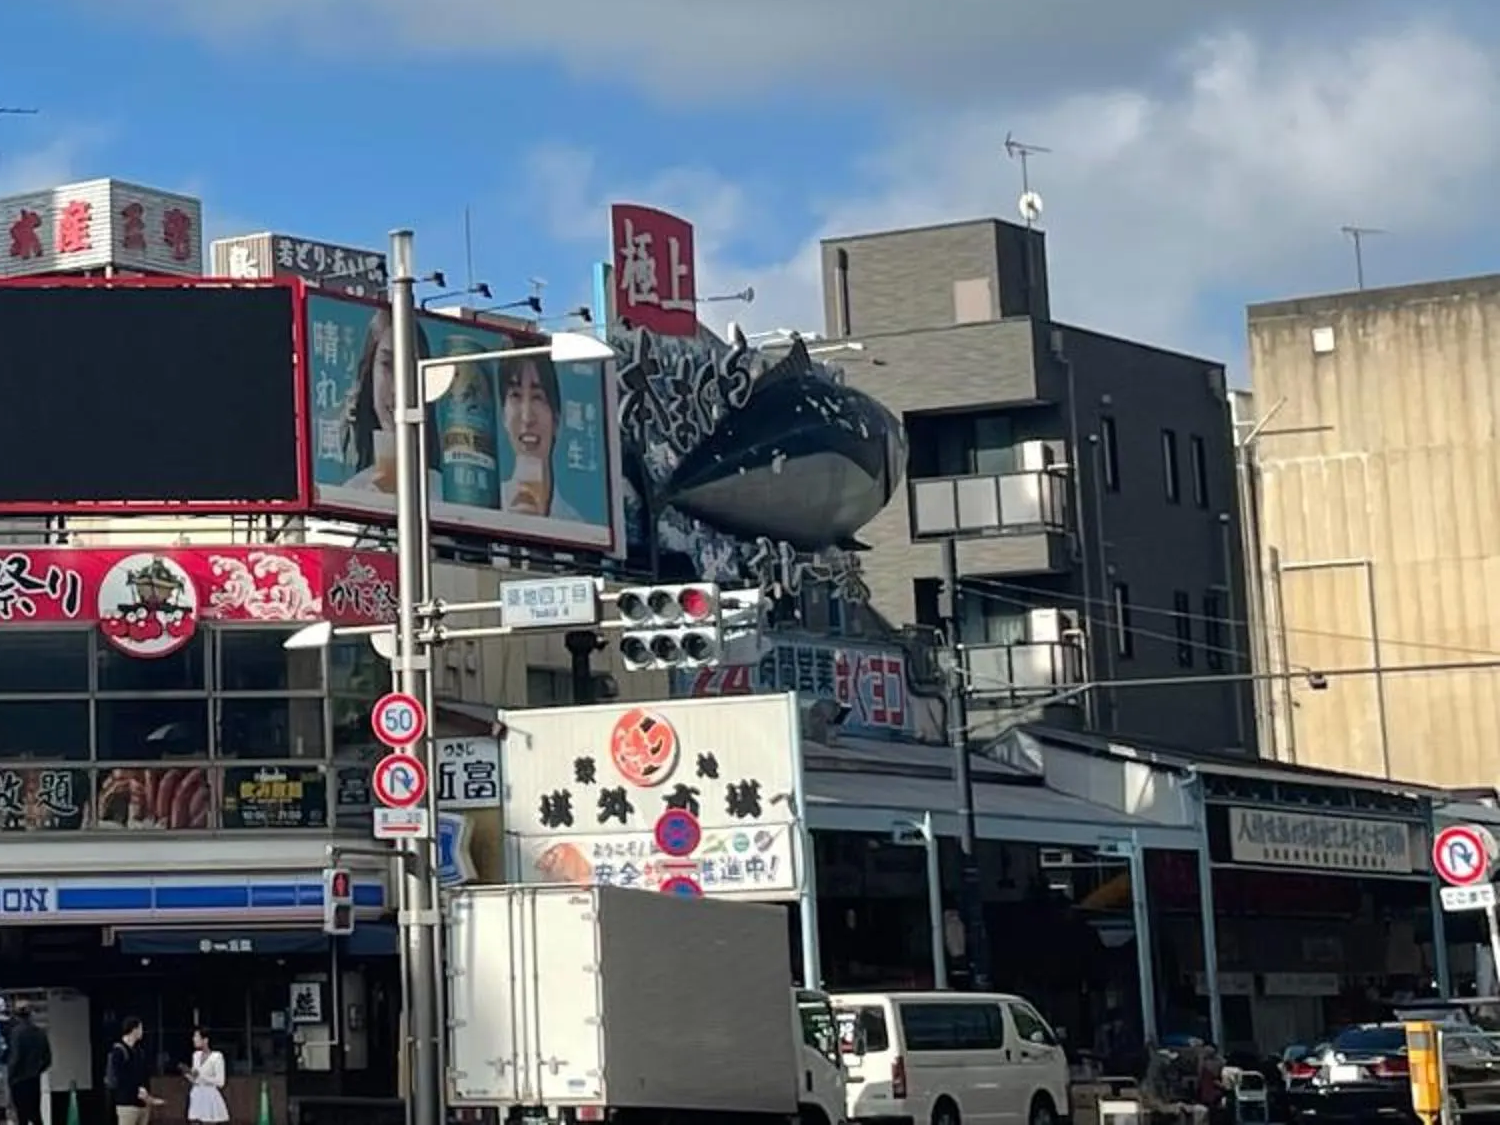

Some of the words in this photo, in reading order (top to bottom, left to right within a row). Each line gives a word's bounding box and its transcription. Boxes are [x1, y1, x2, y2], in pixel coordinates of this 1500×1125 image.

[620, 218, 695, 313] 極上
[311, 319, 345, 465] 晴れ風
[327, 574, 399, 622] かに祭
[384, 708, 413, 732] 50
